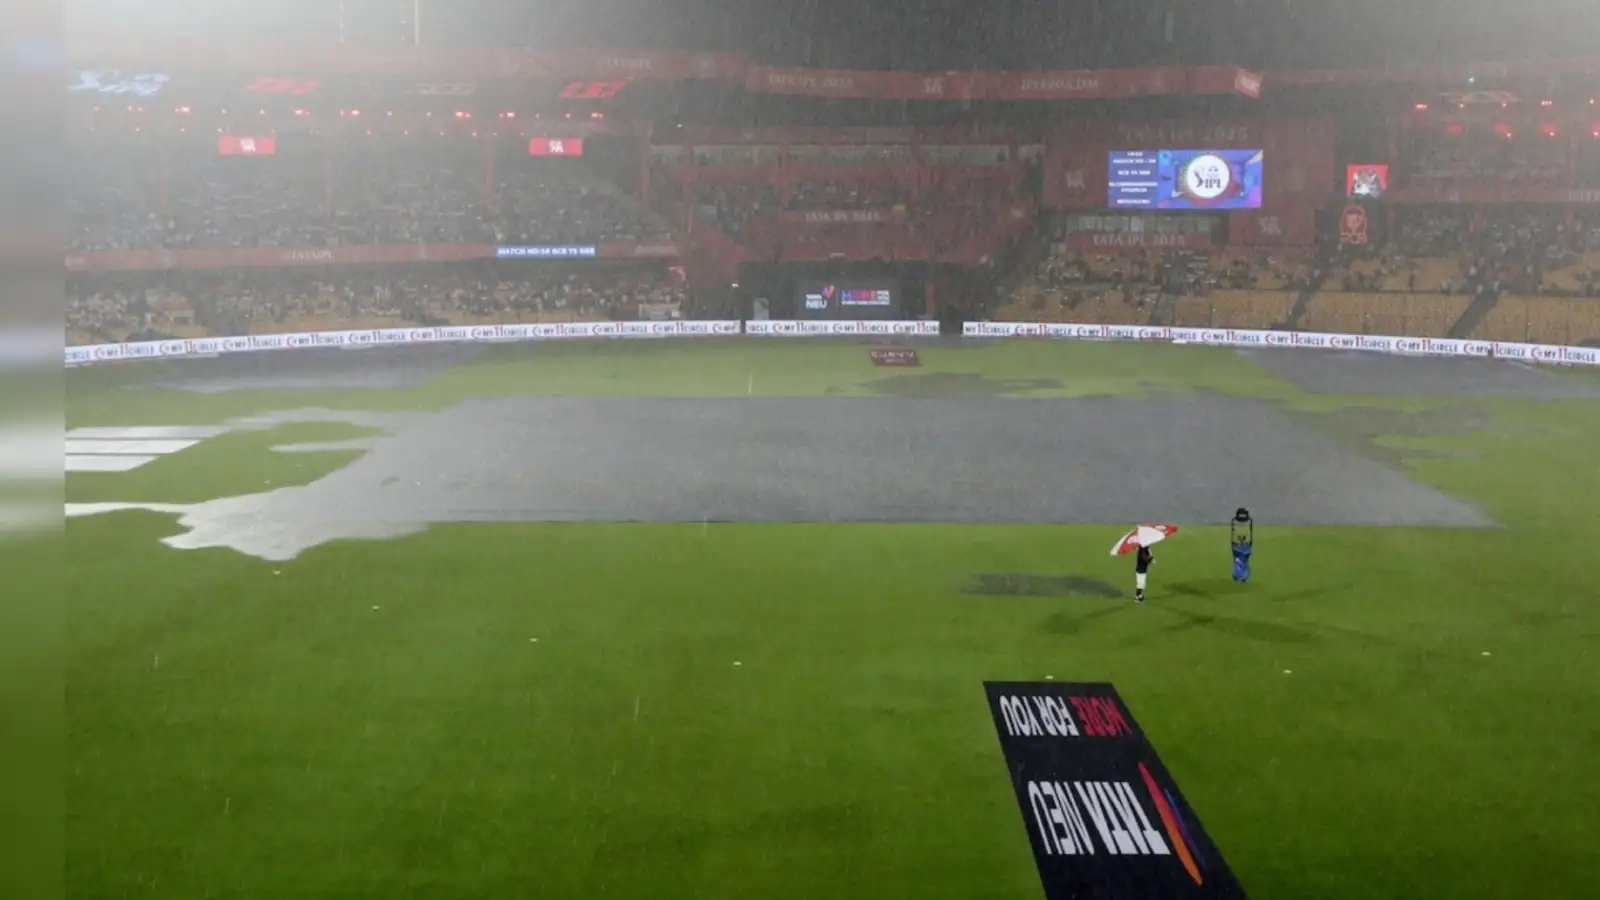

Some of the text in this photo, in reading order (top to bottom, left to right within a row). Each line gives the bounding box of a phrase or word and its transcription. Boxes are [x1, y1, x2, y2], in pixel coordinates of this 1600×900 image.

[999, 696, 1133, 738] MORE FOR YOU
[1028, 781, 1171, 856] TATA NEU
